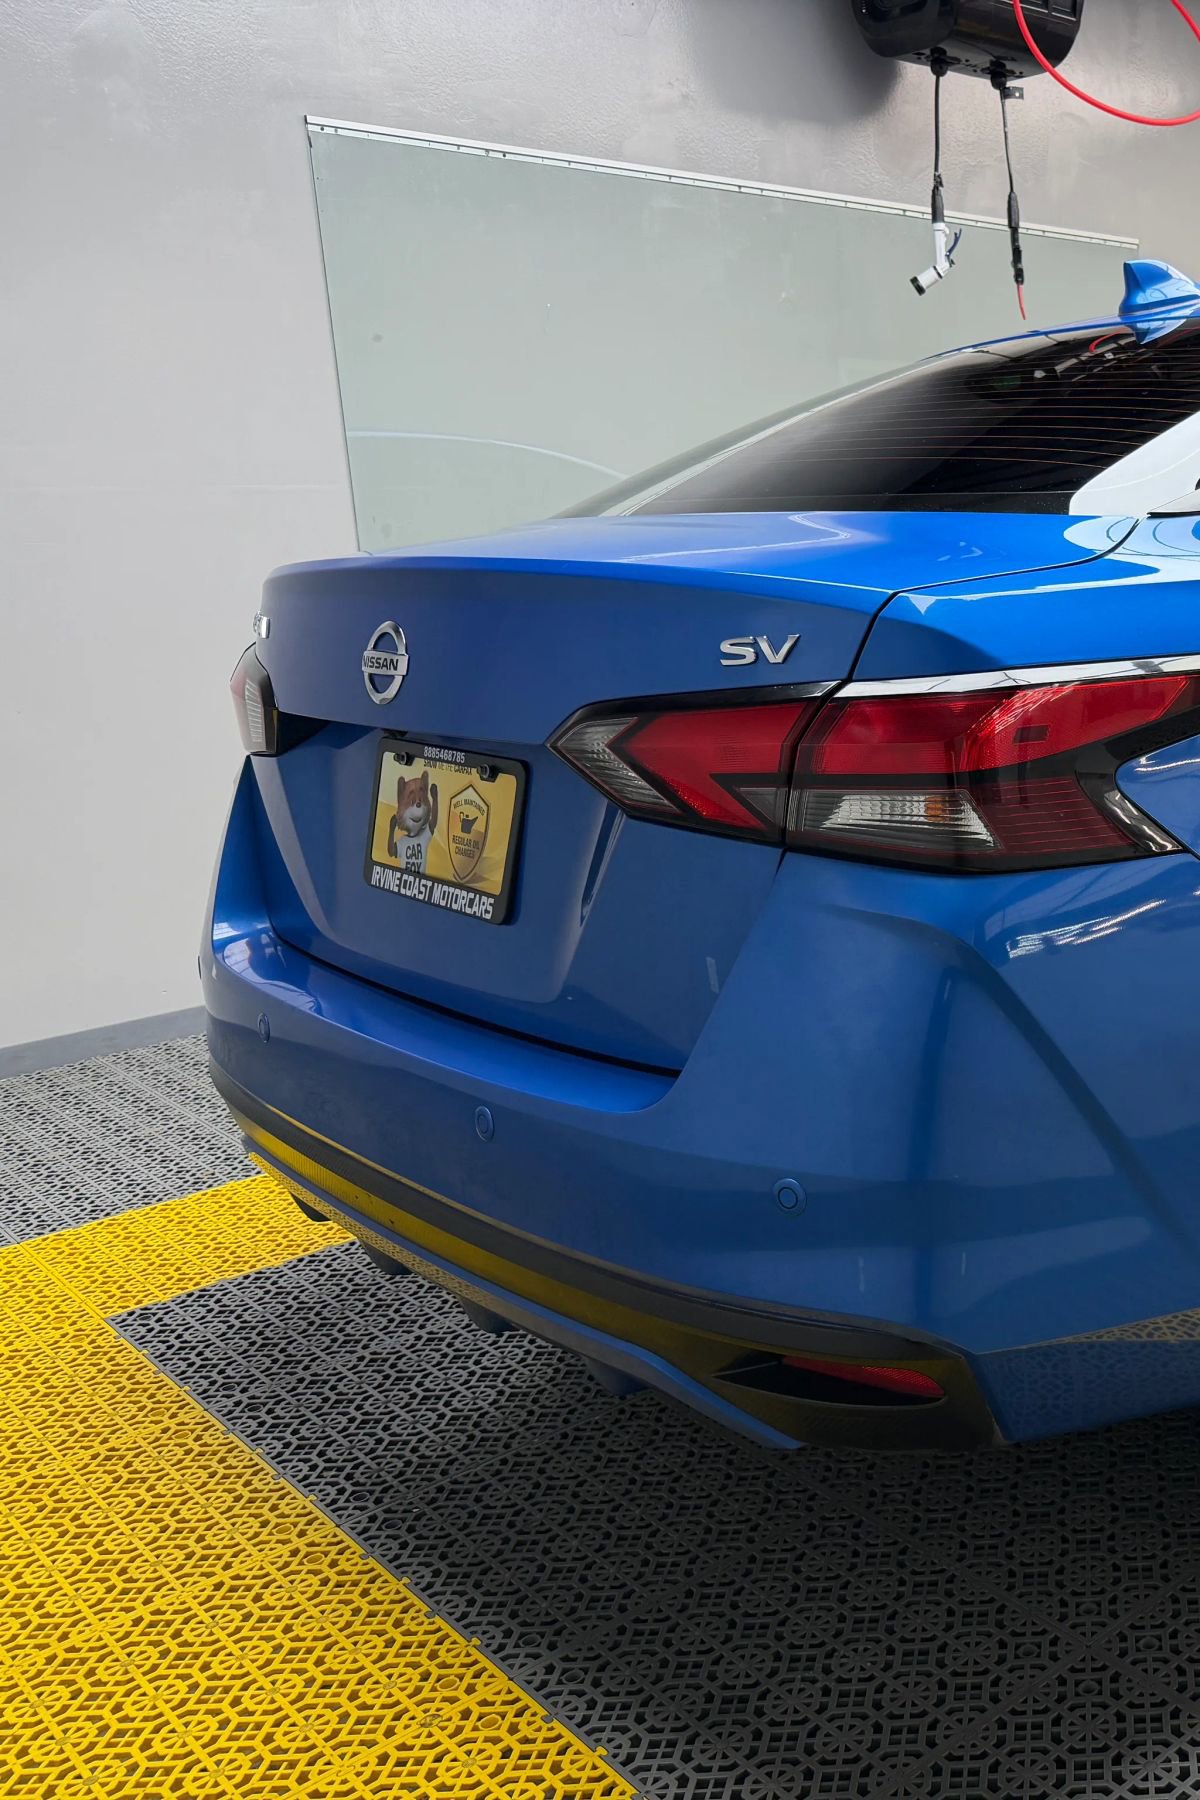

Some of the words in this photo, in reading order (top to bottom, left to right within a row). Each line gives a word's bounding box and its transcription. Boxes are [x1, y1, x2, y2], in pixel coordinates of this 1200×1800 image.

[720, 634, 800, 666] SV
[363, 655, 399, 671] NISSAN
[424, 746, 465, 763] 8885468785
[453, 799, 463, 809] WELL
[464, 799, 485, 816] MAINTAINED
[452, 834, 472, 847] REGULAR
[406, 842, 422, 860] CAR
[455, 846, 475, 859] CHANGES
[371, 865, 400, 892] IRVINE
[401, 875, 433, 901] COAST
[432, 882, 494, 919] MOTORCARS
